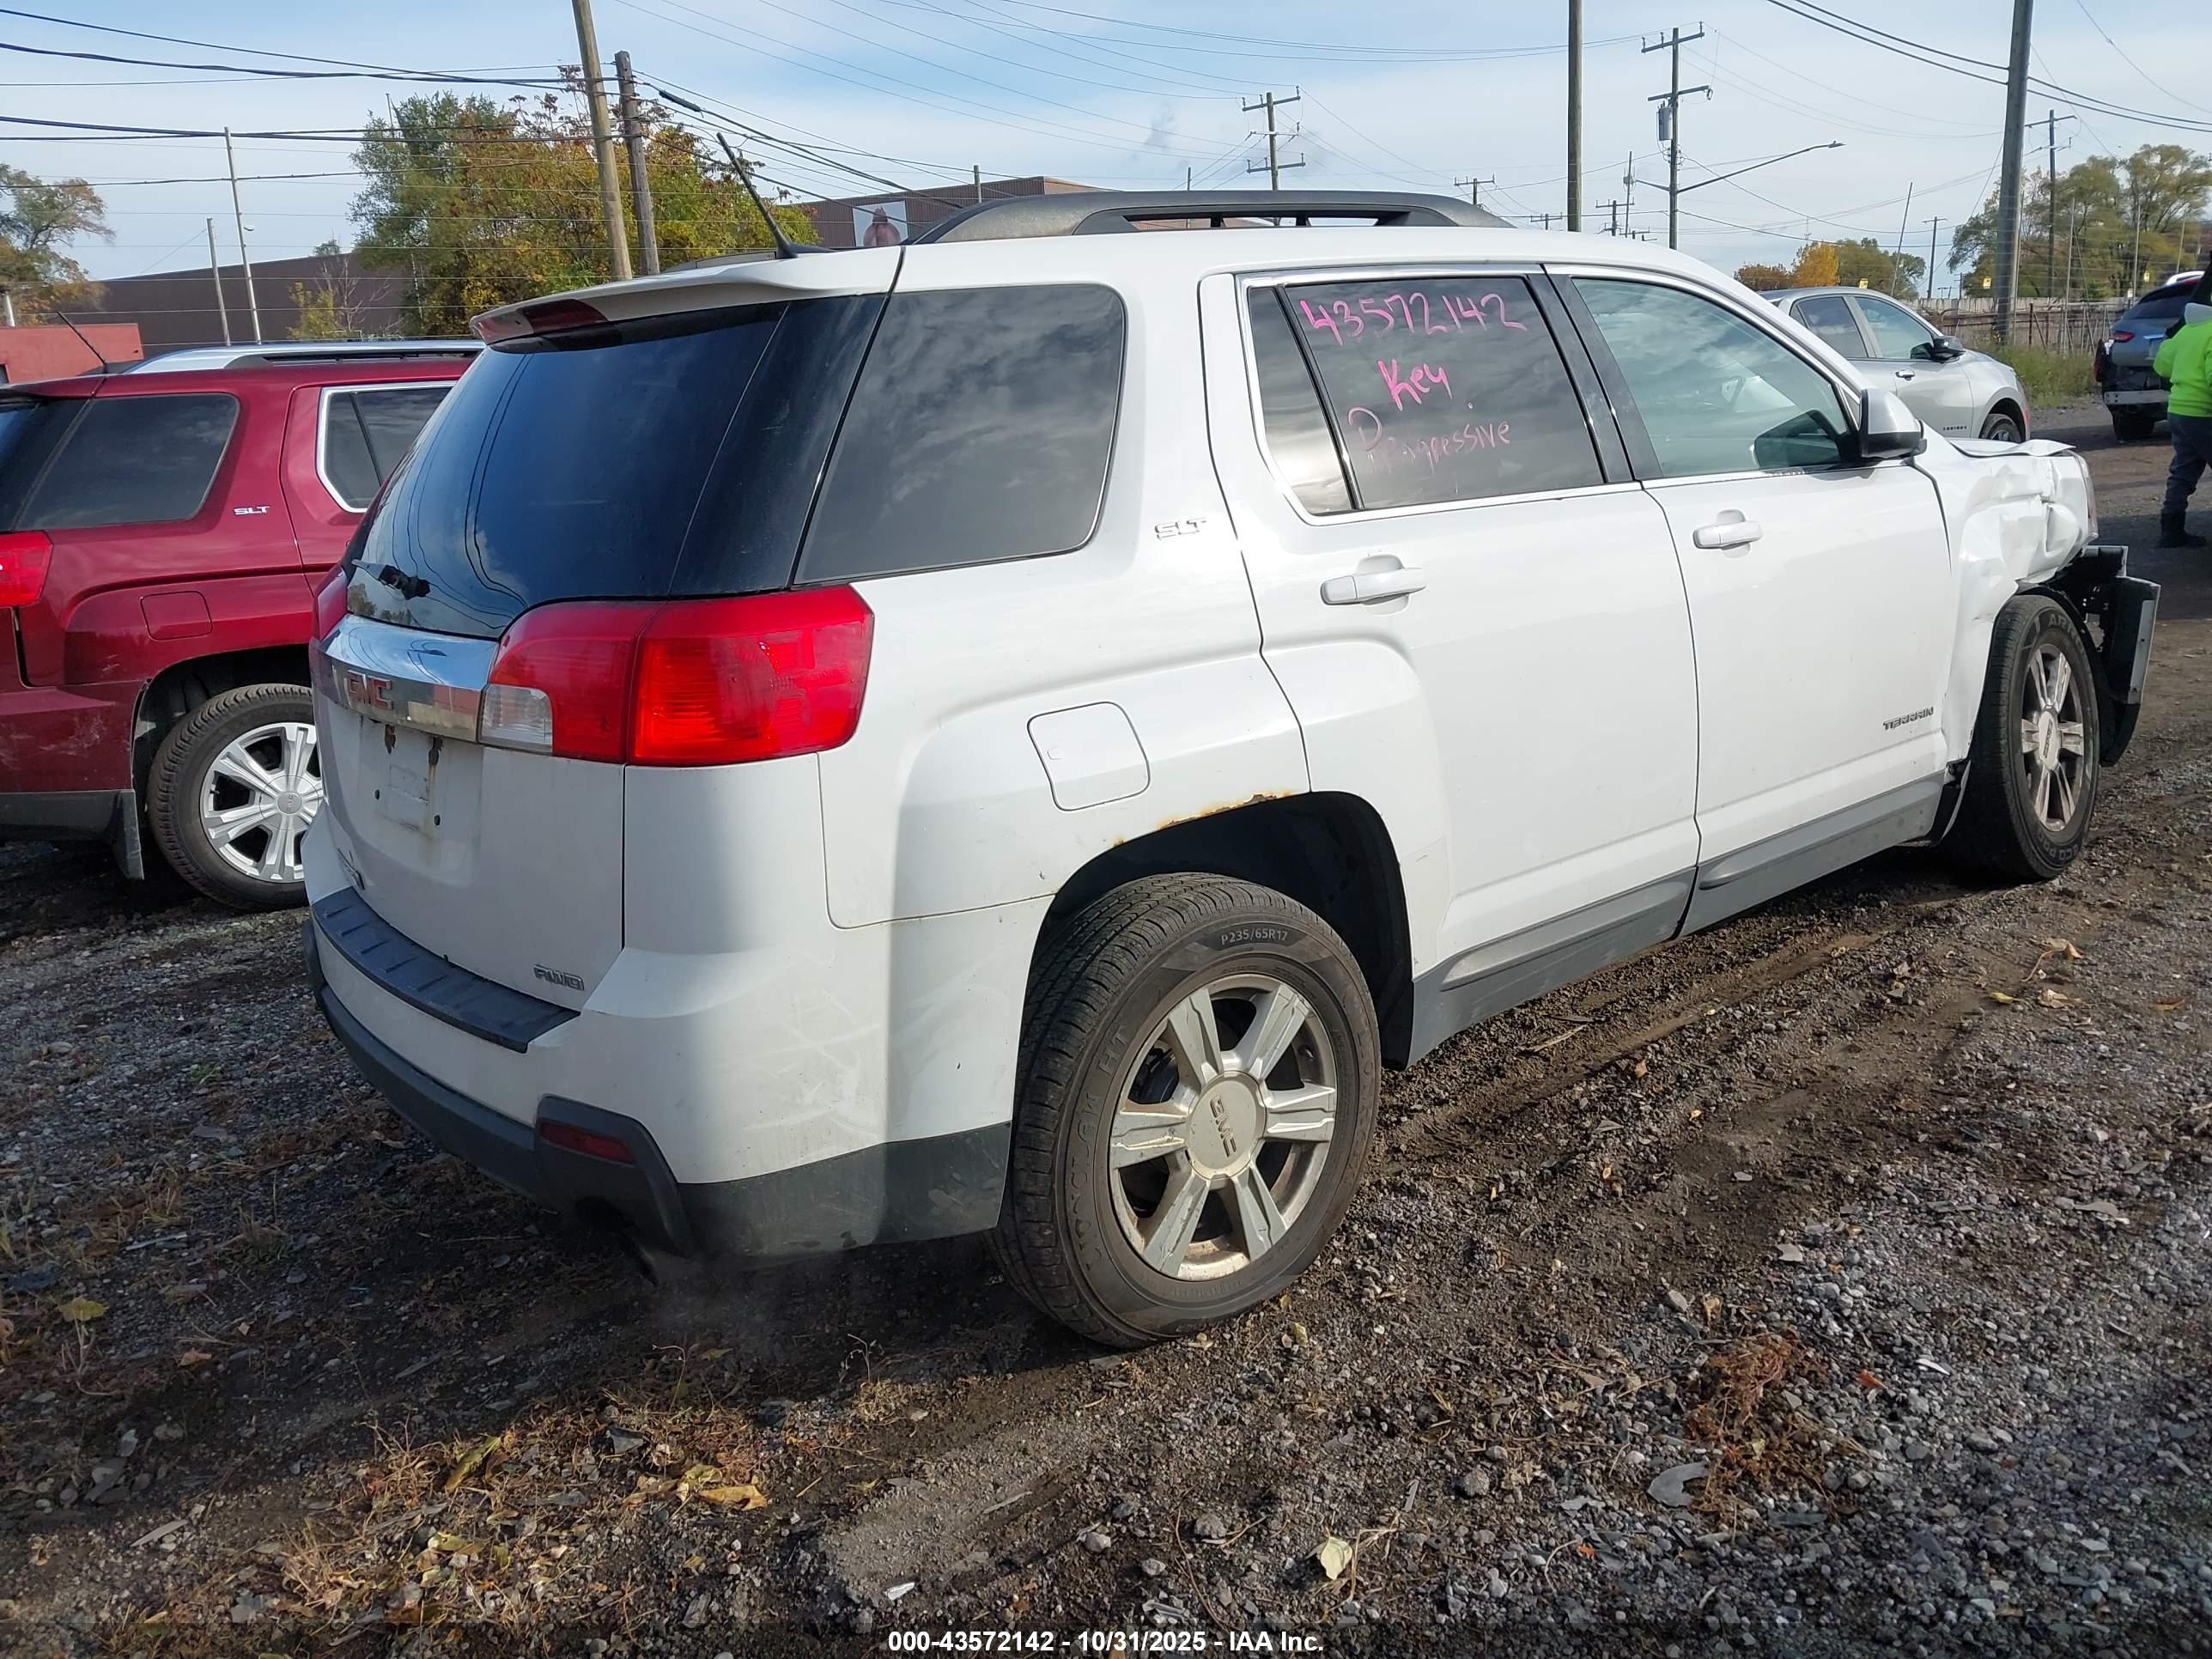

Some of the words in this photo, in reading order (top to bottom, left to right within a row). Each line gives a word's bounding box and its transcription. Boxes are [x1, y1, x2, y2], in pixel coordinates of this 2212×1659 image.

[1299, 292, 1527, 345] 43572142
[1377, 359, 1452, 412] Key
[234, 505, 270, 515] SLT
[1154, 517, 1207, 540] SLT
[343, 669, 394, 710] GMC
[1882, 706, 1934, 731] TERRAIN
[1220, 927, 1288, 945] P235/65R17
[1209, 1097, 1237, 1158] GMC
